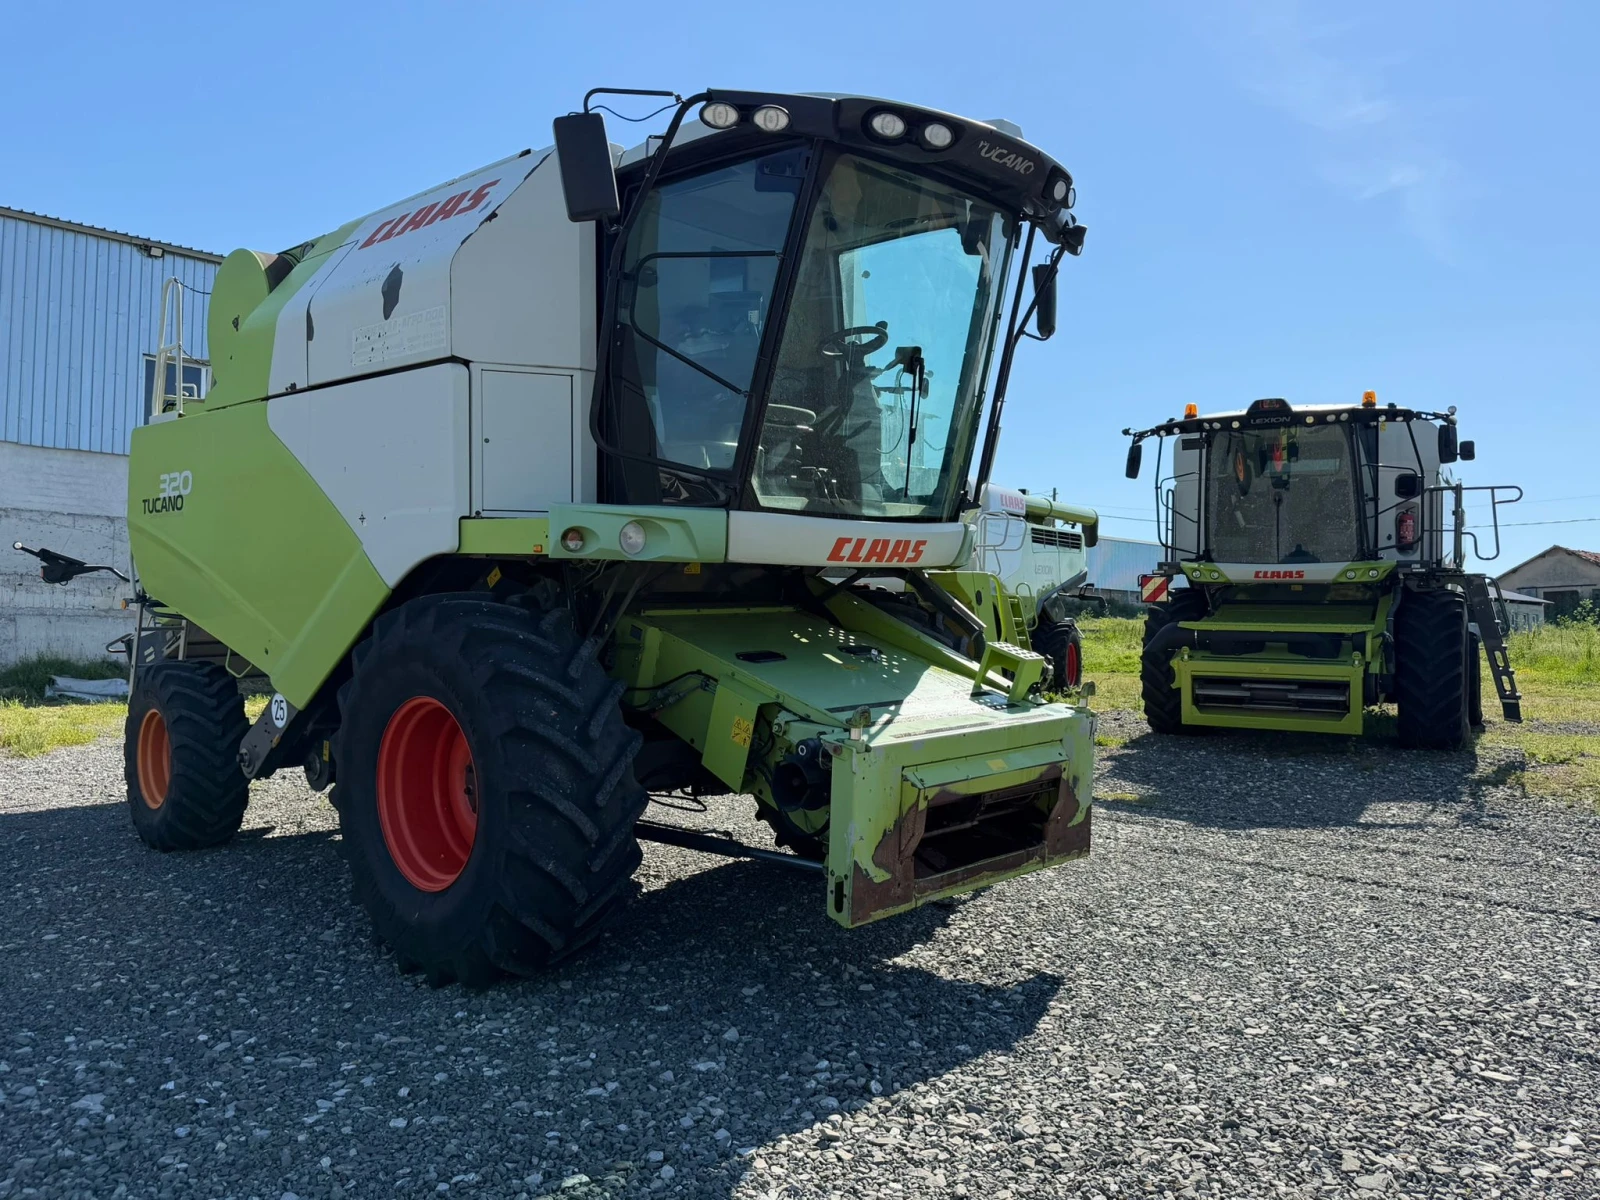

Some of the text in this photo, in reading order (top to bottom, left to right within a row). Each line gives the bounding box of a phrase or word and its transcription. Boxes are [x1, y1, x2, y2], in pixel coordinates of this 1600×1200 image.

[358, 178, 502, 250] CLAAS
[1250, 416, 1291, 425] LEXION
[159, 470, 193, 498] 320
[142, 495, 184, 515] TUCANO
[1000, 493, 1025, 510] CLAAS
[826, 537, 928, 563] CLAAS
[1034, 563, 1053, 575] LEXION
[1253, 570, 1304, 579] CLAAS
[274, 699, 285, 721] 25
